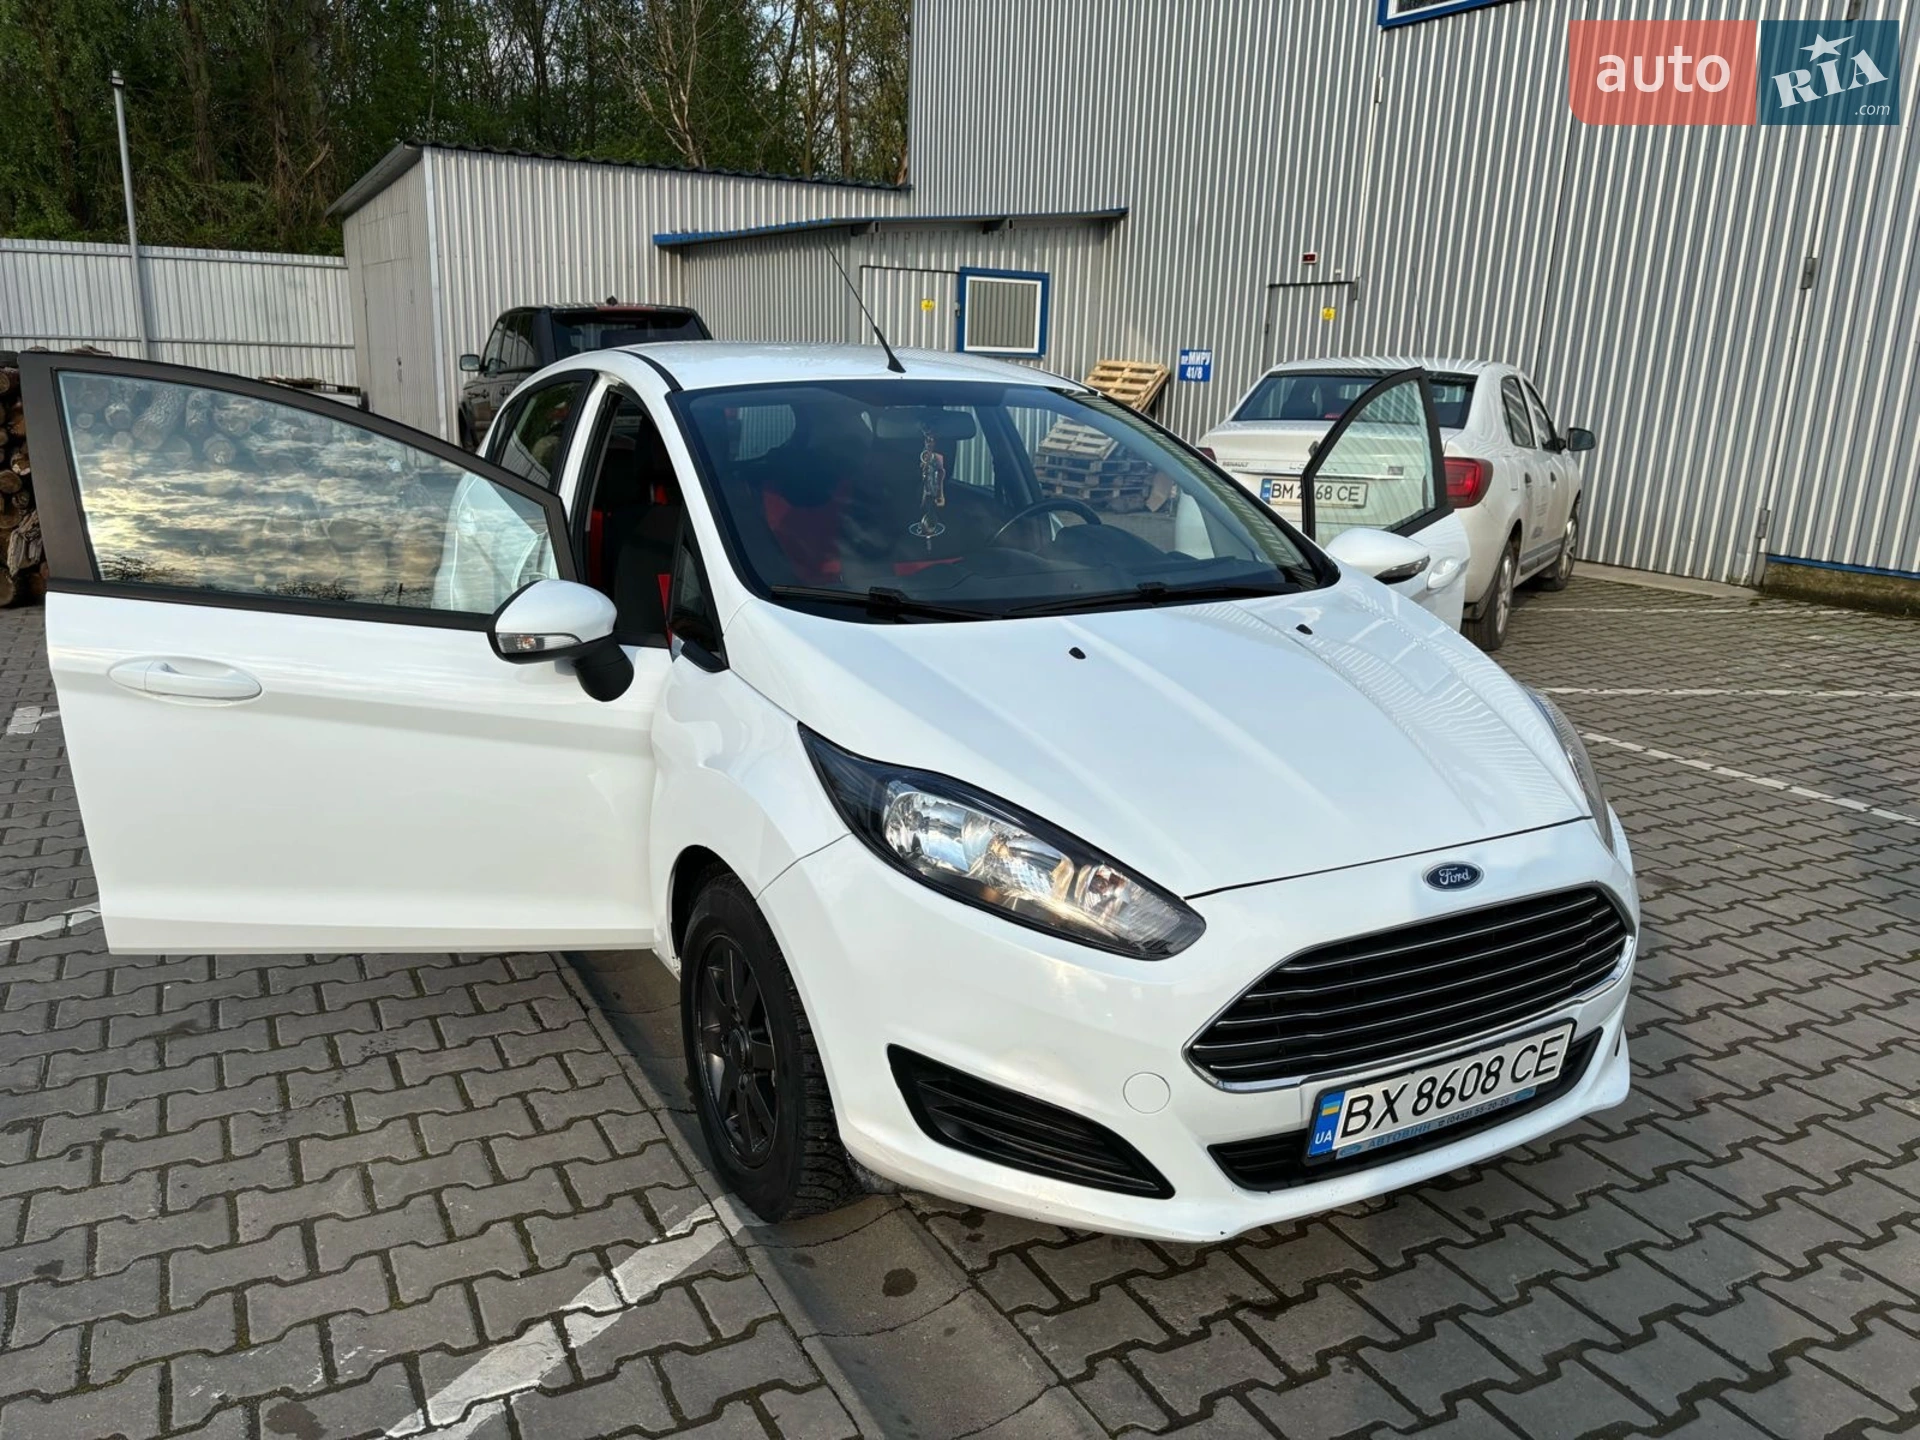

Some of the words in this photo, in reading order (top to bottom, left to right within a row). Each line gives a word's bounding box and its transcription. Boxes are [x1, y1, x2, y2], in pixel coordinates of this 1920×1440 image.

[1186, 366, 1203, 379] 41/8
[1271, 483, 1294, 499] BM
[1337, 486, 1360, 502] CE
[1438, 867, 1471, 885] Ford
[1340, 1084, 1408, 1139] BX
[1411, 1055, 1505, 1117] 8608
[1510, 1031, 1565, 1083] CE
[1314, 1130, 1333, 1145] UA
